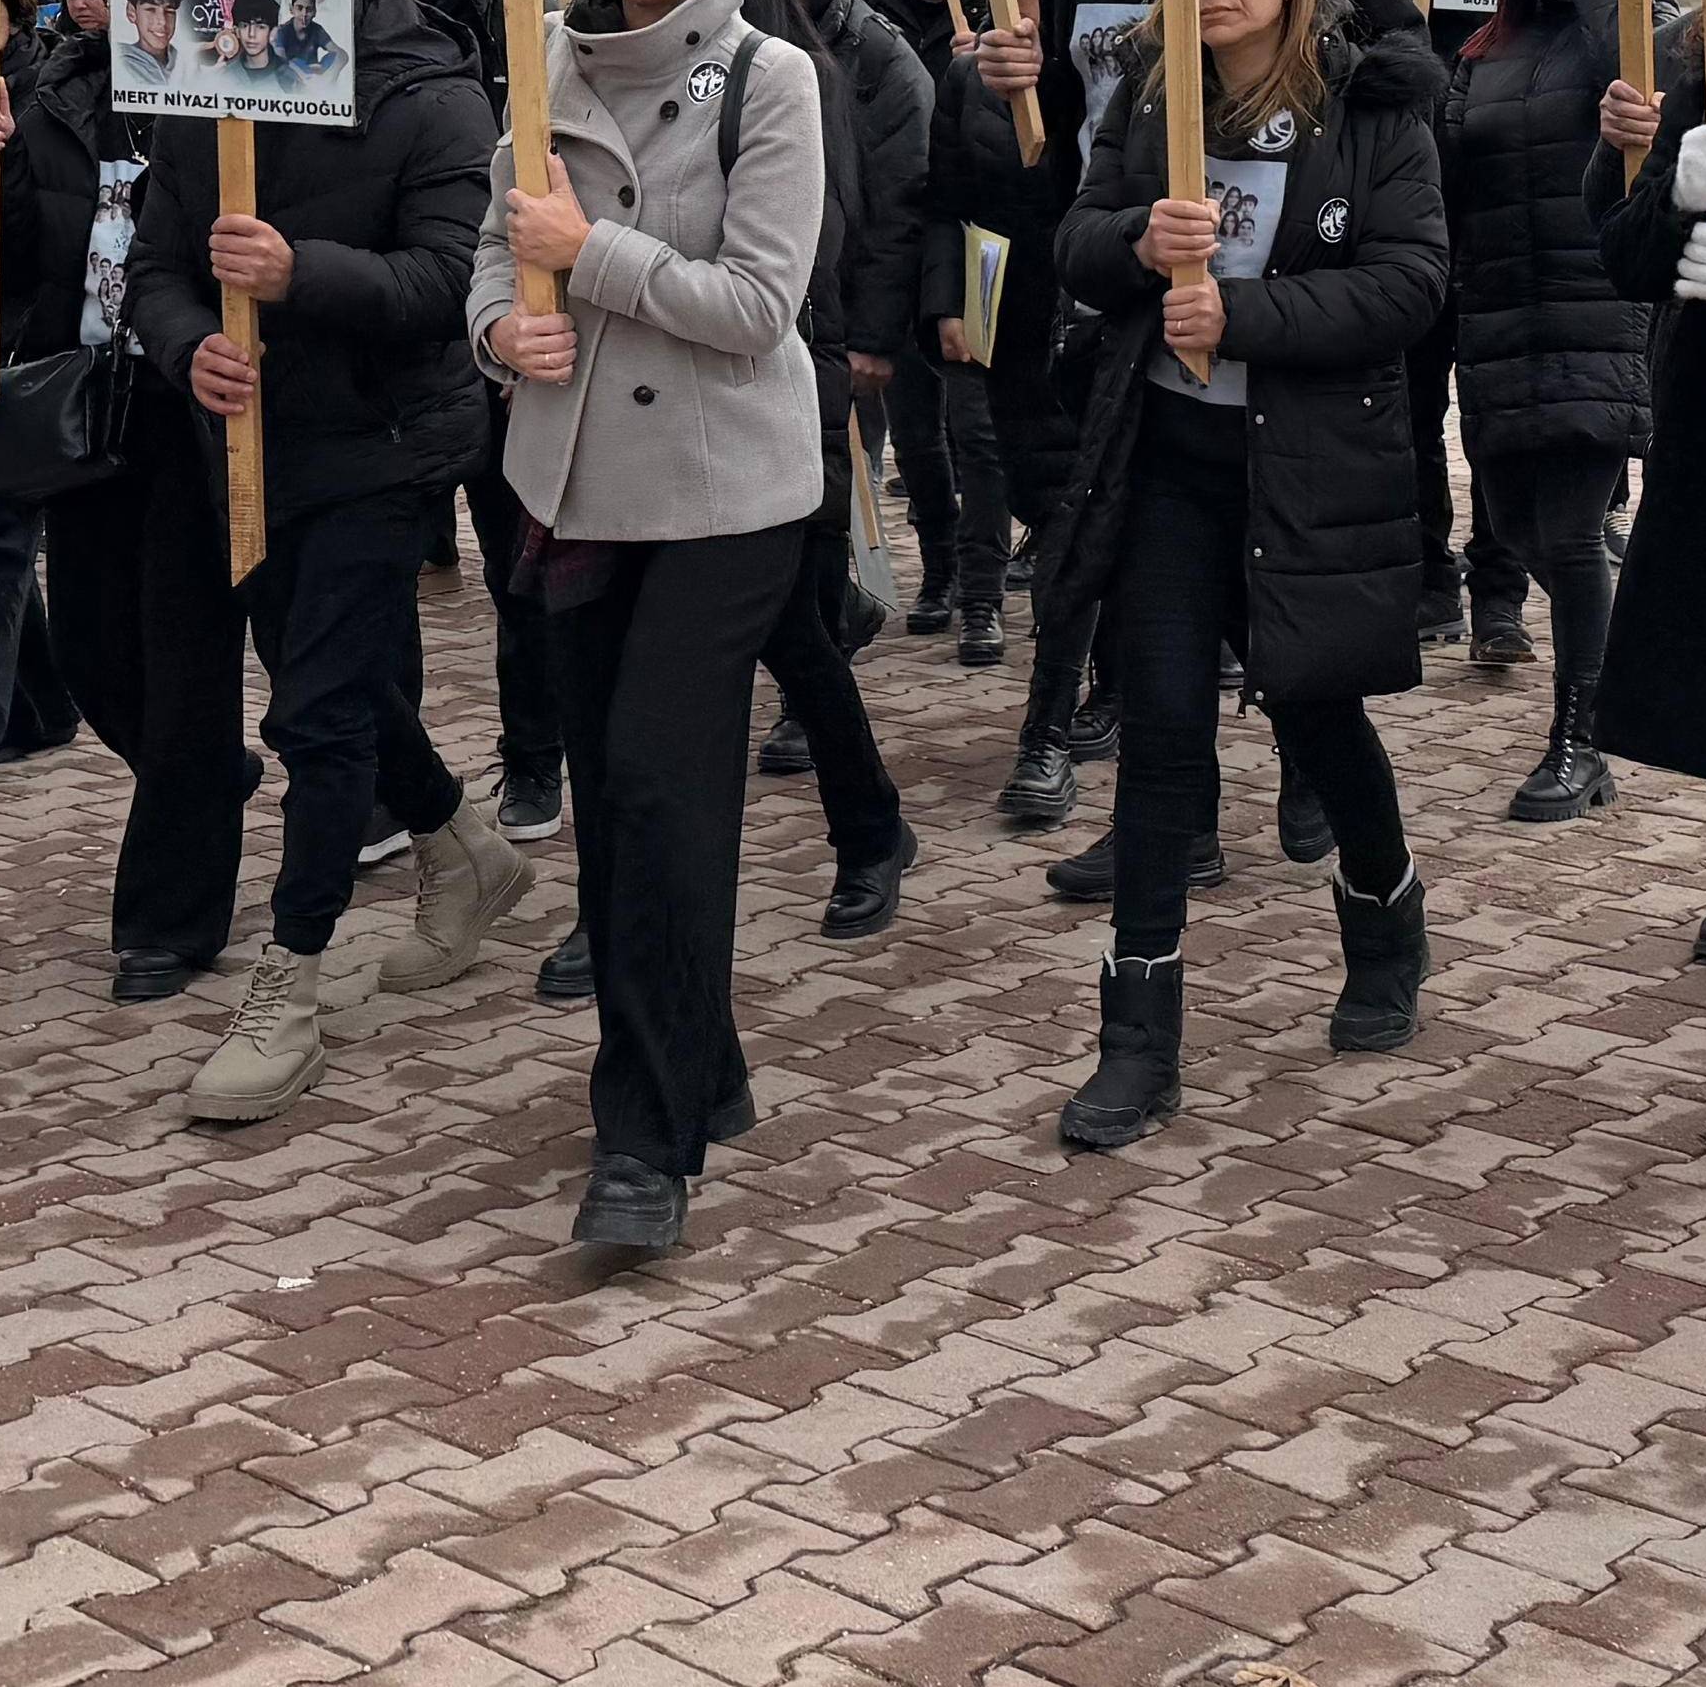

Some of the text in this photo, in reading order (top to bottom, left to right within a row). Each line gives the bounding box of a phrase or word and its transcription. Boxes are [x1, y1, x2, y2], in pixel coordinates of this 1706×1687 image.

[113, 89, 352, 118] MERT NİYAZİ TOPUKÇUOĞLU
